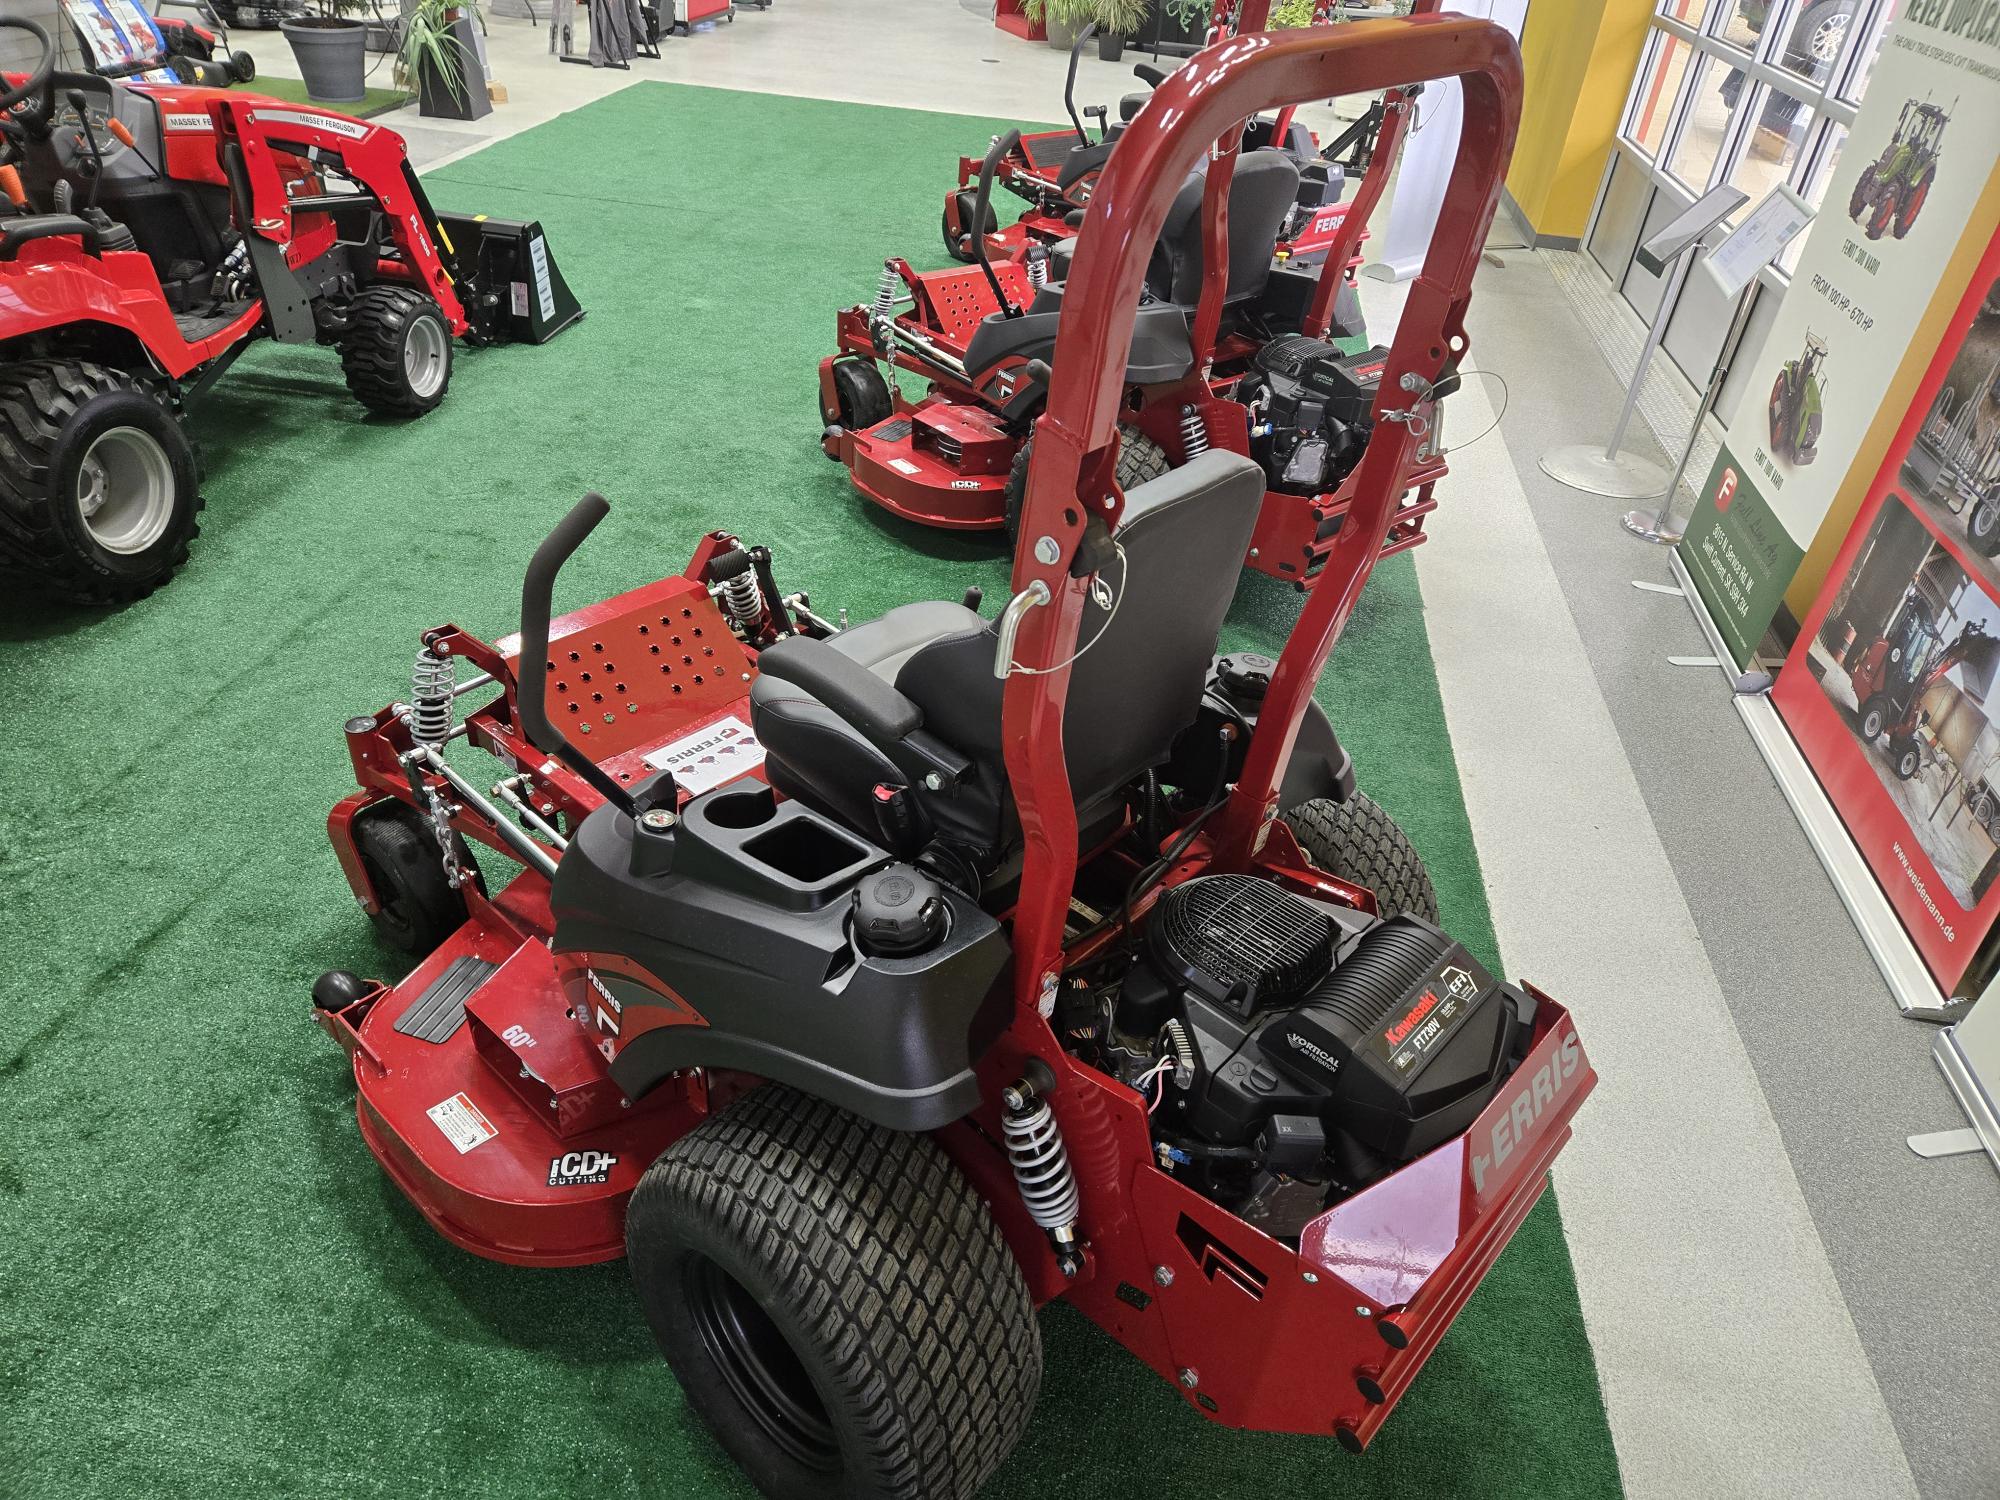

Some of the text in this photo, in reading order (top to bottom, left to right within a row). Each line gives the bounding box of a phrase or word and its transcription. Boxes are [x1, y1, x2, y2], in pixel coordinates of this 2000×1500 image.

[170, 117, 201, 126] MASSEY
[300, 114, 356, 134] MASSEY FERGUSON
[1811, 273, 1831, 297] FROM
[1828, 288, 1840, 306] 100
[1838, 296, 1850, 312] HP
[1849, 307, 1864, 325] 670
[1861, 315, 1874, 332] HP
[1702, 536, 1714, 559] Swift
[1724, 573, 1734, 591] SK
[1712, 522, 1726, 545] 3015
[1725, 544, 1741, 575] Service
[667, 736, 724, 764] FERRIS
[1893, 841, 1955, 942] www.weidemann.de
[587, 968, 622, 1014] FERRIS
[1449, 972, 1468, 994] EFI
[1385, 984, 1438, 1046] Kawasaki
[501, 1024, 537, 1048] 60"
[1286, 1033, 1339, 1068] VORTICAL
[1412, 1017, 1441, 1050] FT730V
[1300, 1047, 1337, 1073] AIR FILTRATION
[1472, 1031, 1579, 1194] FERRIS
[549, 1174, 606, 1186] CUTTING
